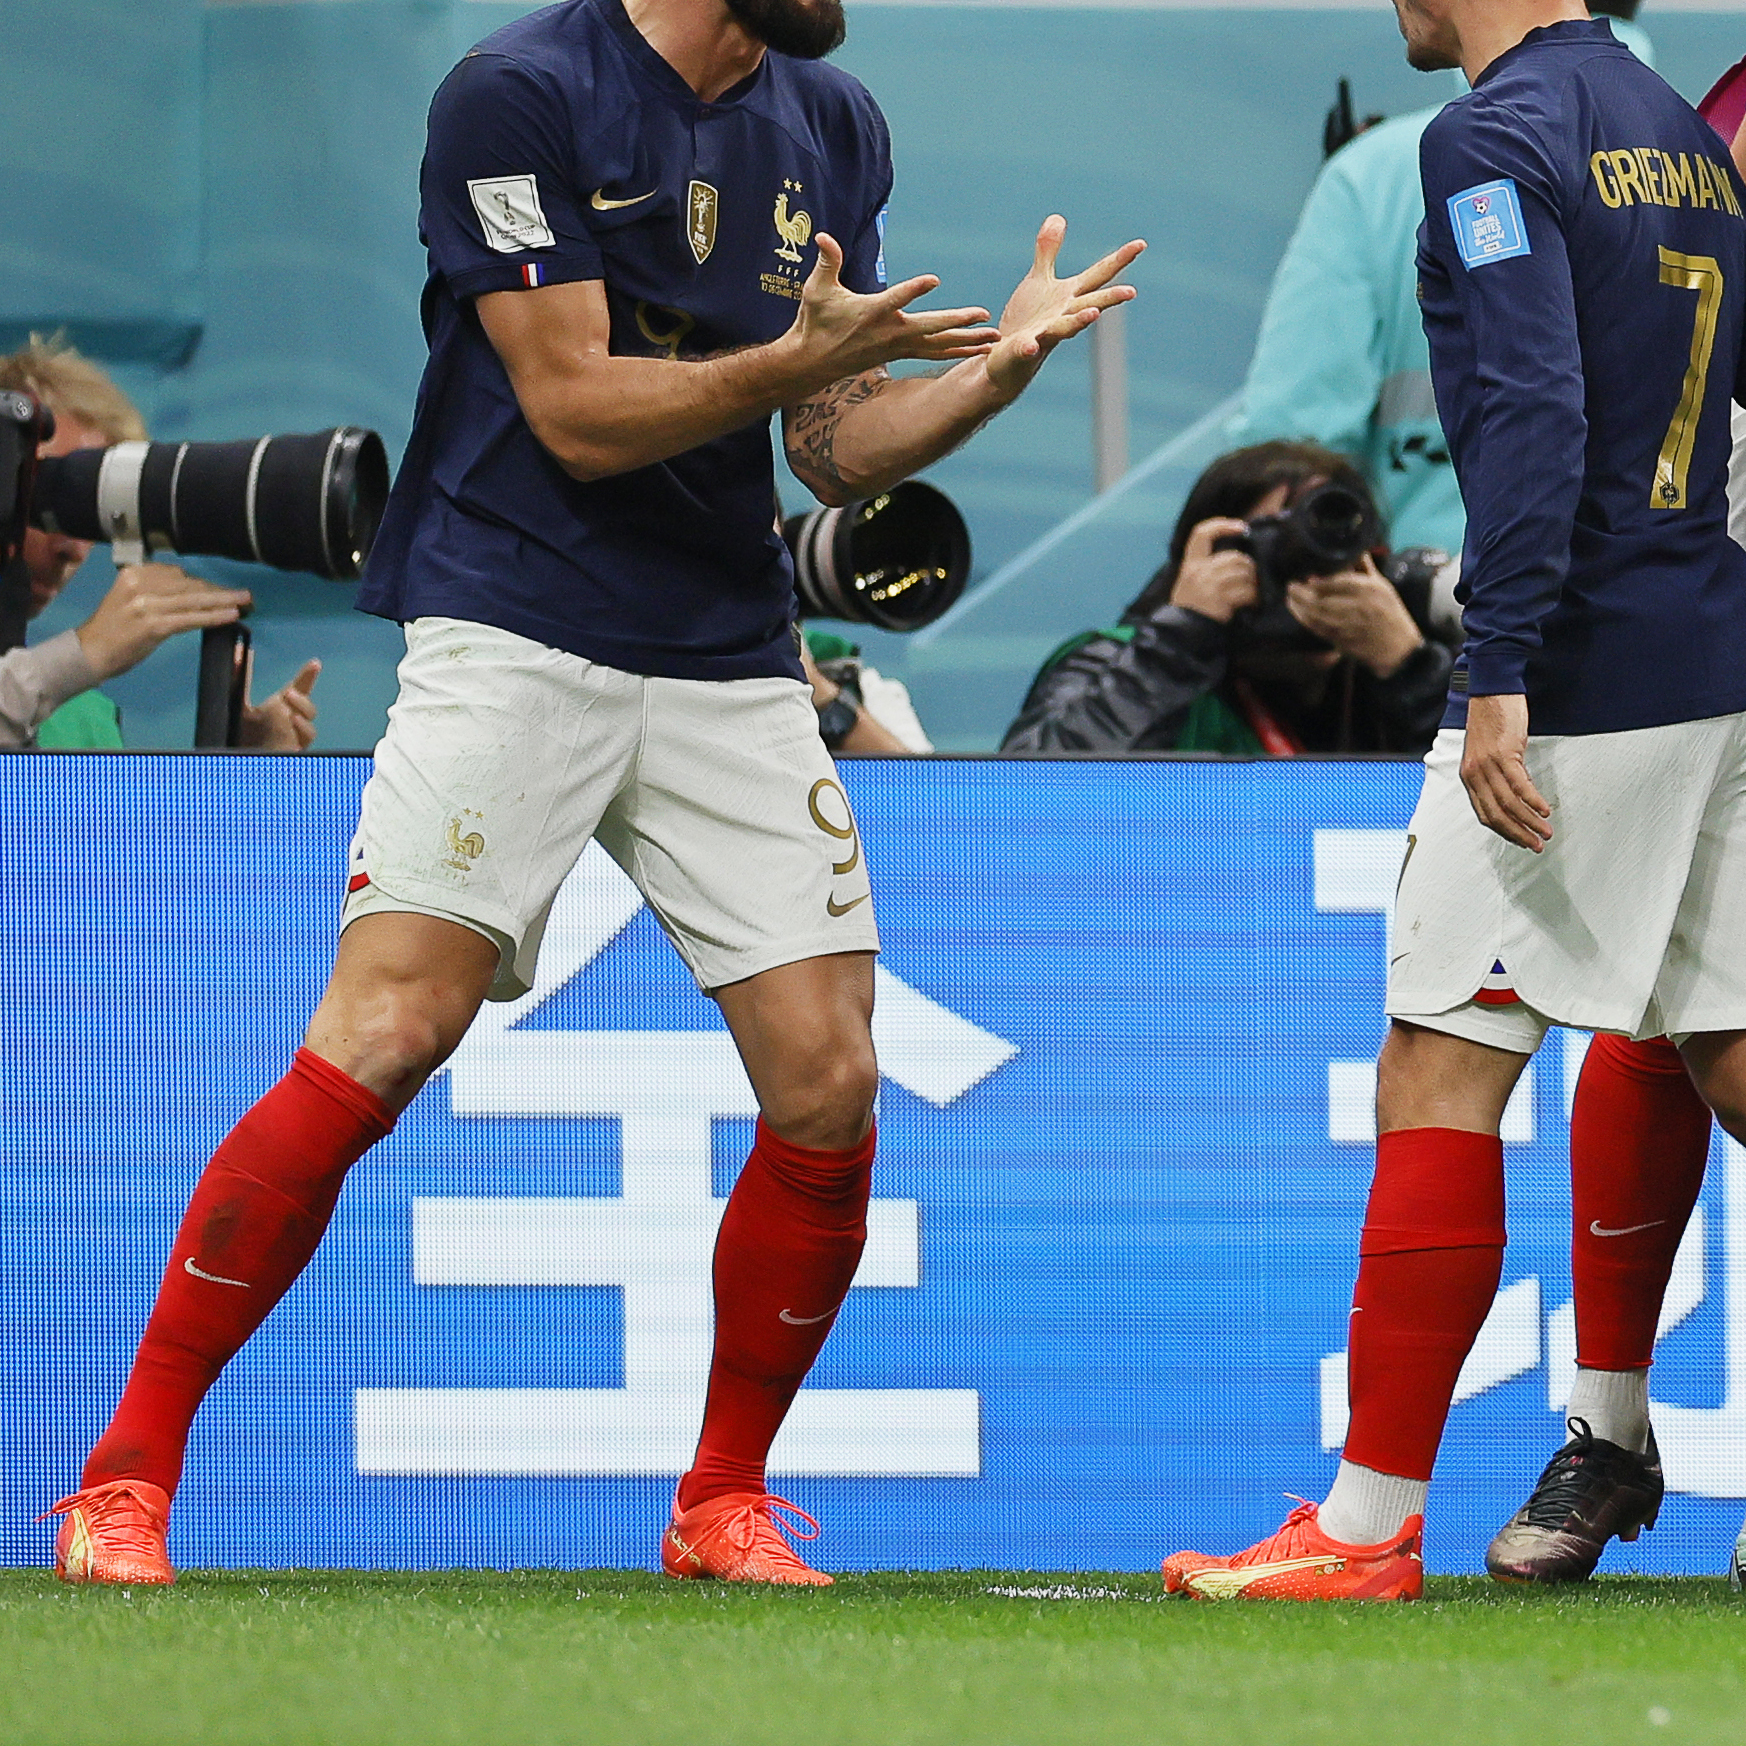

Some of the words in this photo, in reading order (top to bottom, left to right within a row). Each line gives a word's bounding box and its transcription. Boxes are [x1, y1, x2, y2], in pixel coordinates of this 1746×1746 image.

[1473, 222, 1502, 238] UNITES
[1650, 244, 1724, 510] 7
[808, 778, 859, 874] 9
